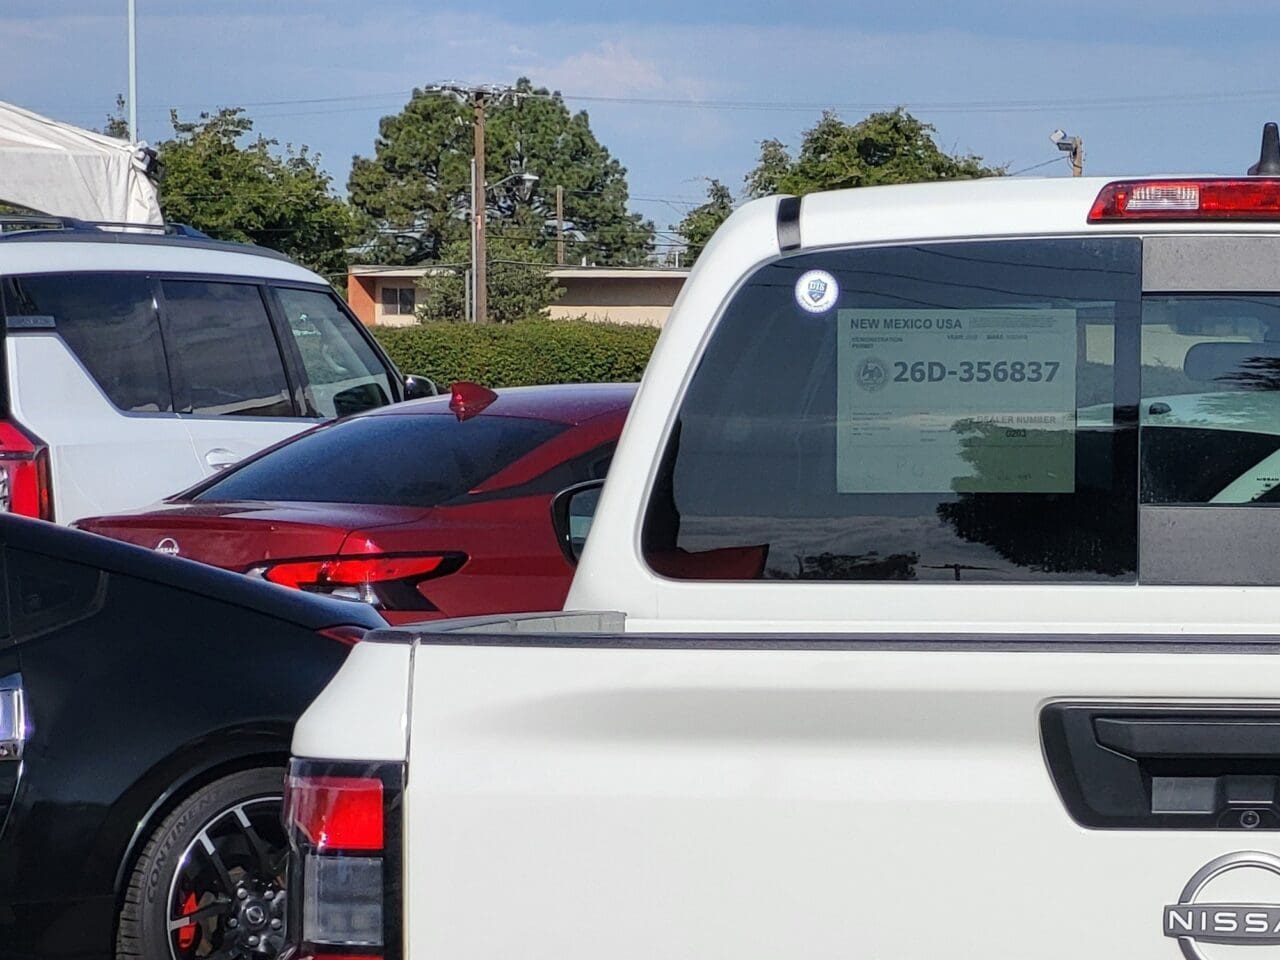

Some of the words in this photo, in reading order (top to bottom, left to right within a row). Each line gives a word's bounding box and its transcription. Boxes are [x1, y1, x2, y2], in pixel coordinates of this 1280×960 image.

[850, 318, 880, 330] NEW
[883, 318, 933, 330] MEXICO
[935, 318, 963, 330] USA
[893, 360, 1060, 384] 26D-356837
[1016, 415, 1056, 424] NUMBER
